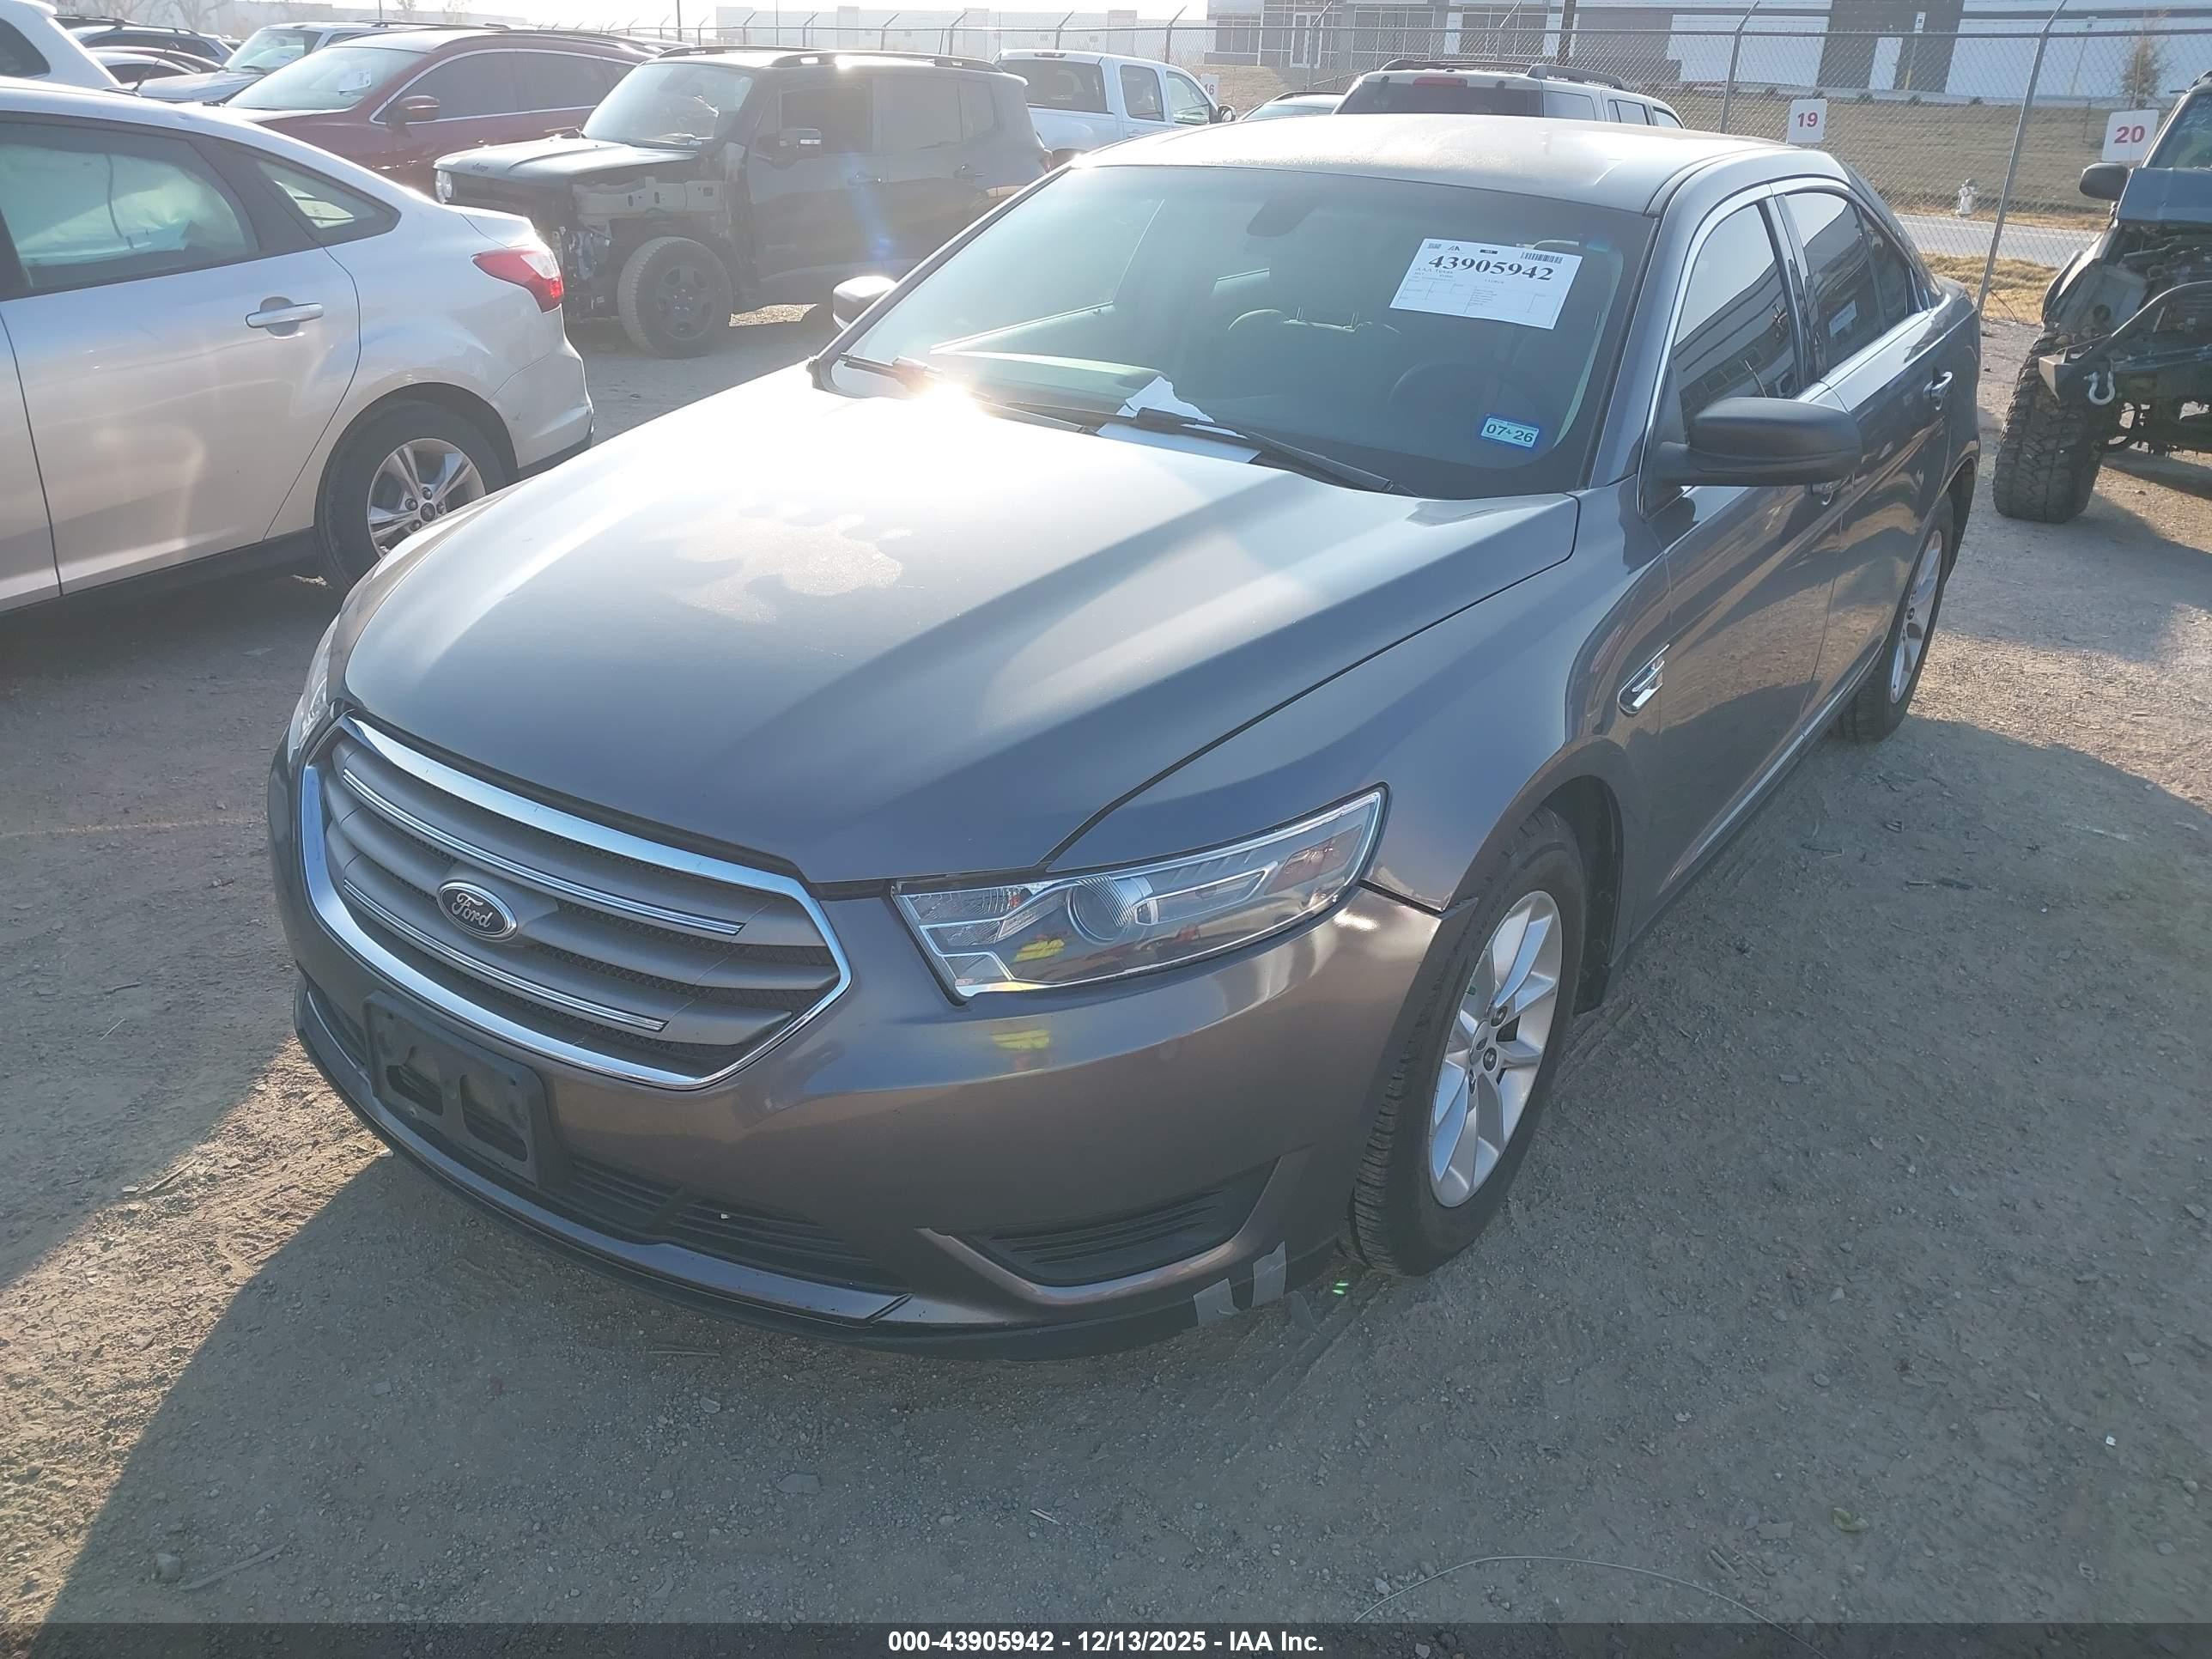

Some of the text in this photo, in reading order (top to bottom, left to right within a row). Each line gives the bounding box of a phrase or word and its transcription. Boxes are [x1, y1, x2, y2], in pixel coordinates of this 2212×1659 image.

[1204, 83, 1215, 96] 16
[1797, 112, 1818, 128] 19
[2113, 125, 2146, 144] 20
[1428, 255, 1554, 281] 43905942
[452, 892, 494, 928] Ford
